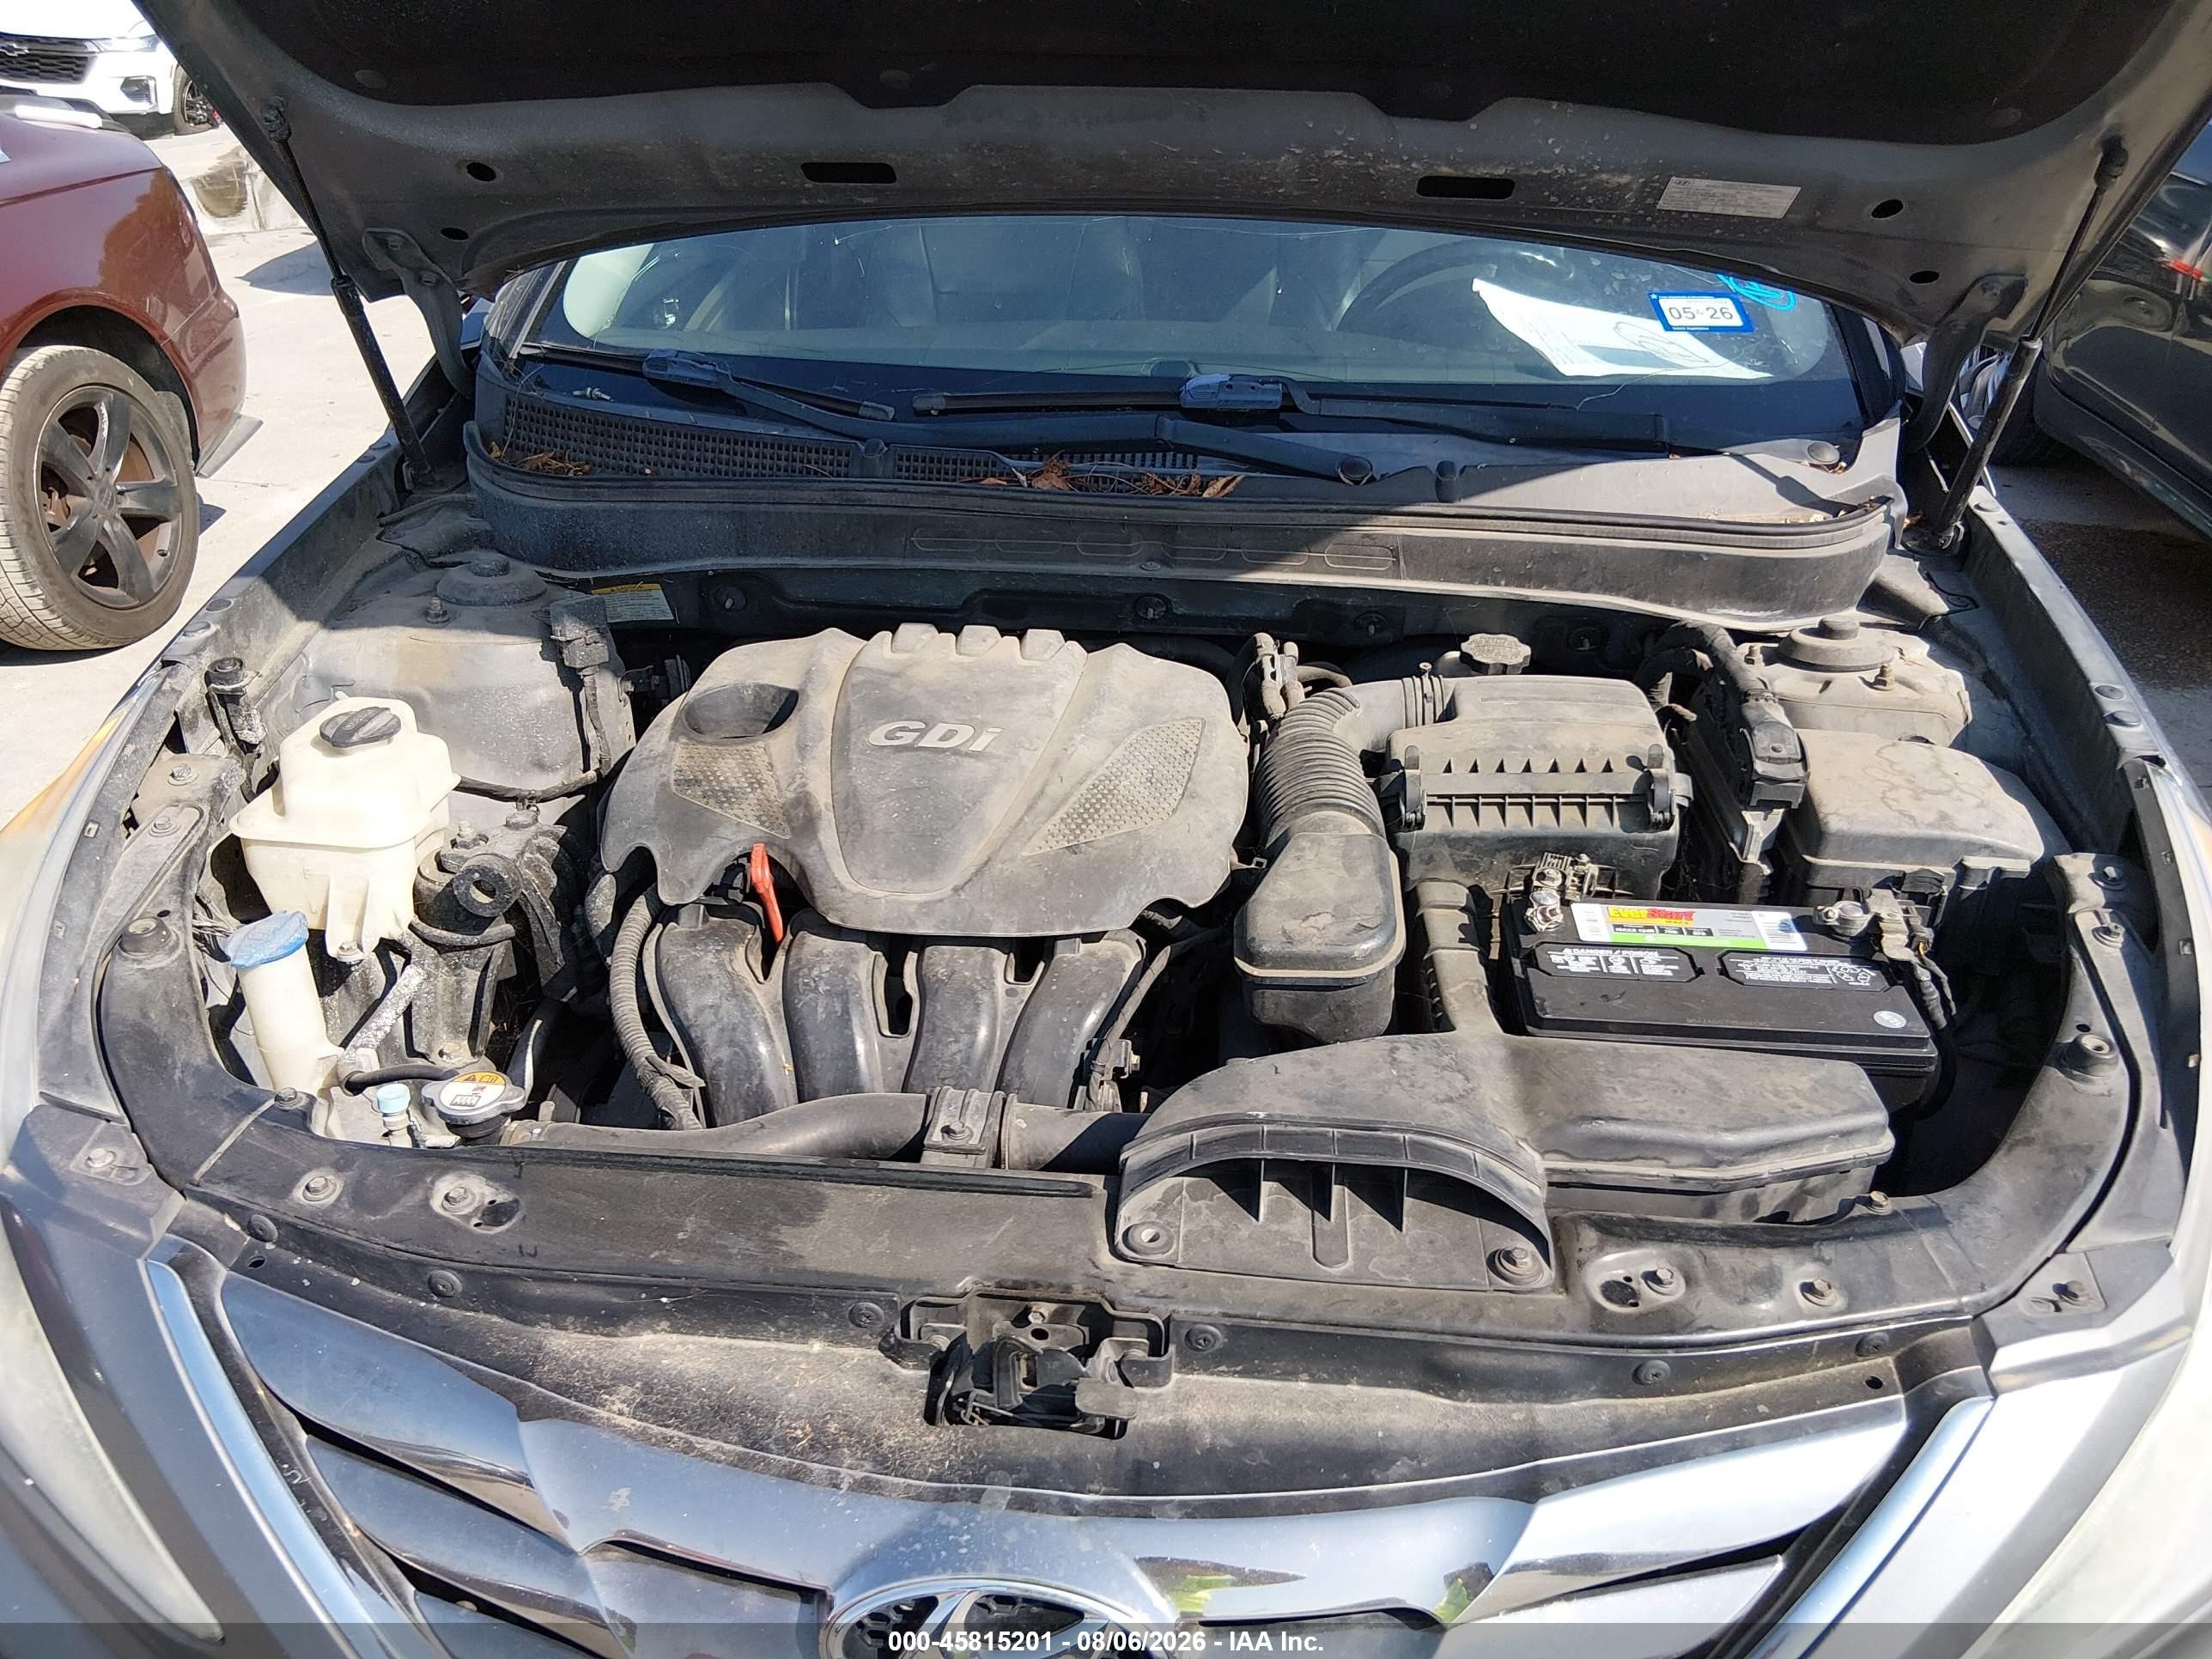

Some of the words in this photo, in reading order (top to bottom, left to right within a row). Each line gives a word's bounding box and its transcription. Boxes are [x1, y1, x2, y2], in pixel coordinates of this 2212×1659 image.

[1668, 307, 1696, 320] 05
[1705, 307, 1733, 320] 26
[868, 720, 1004, 751] GDi
[1608, 906, 1694, 921] EverStart
